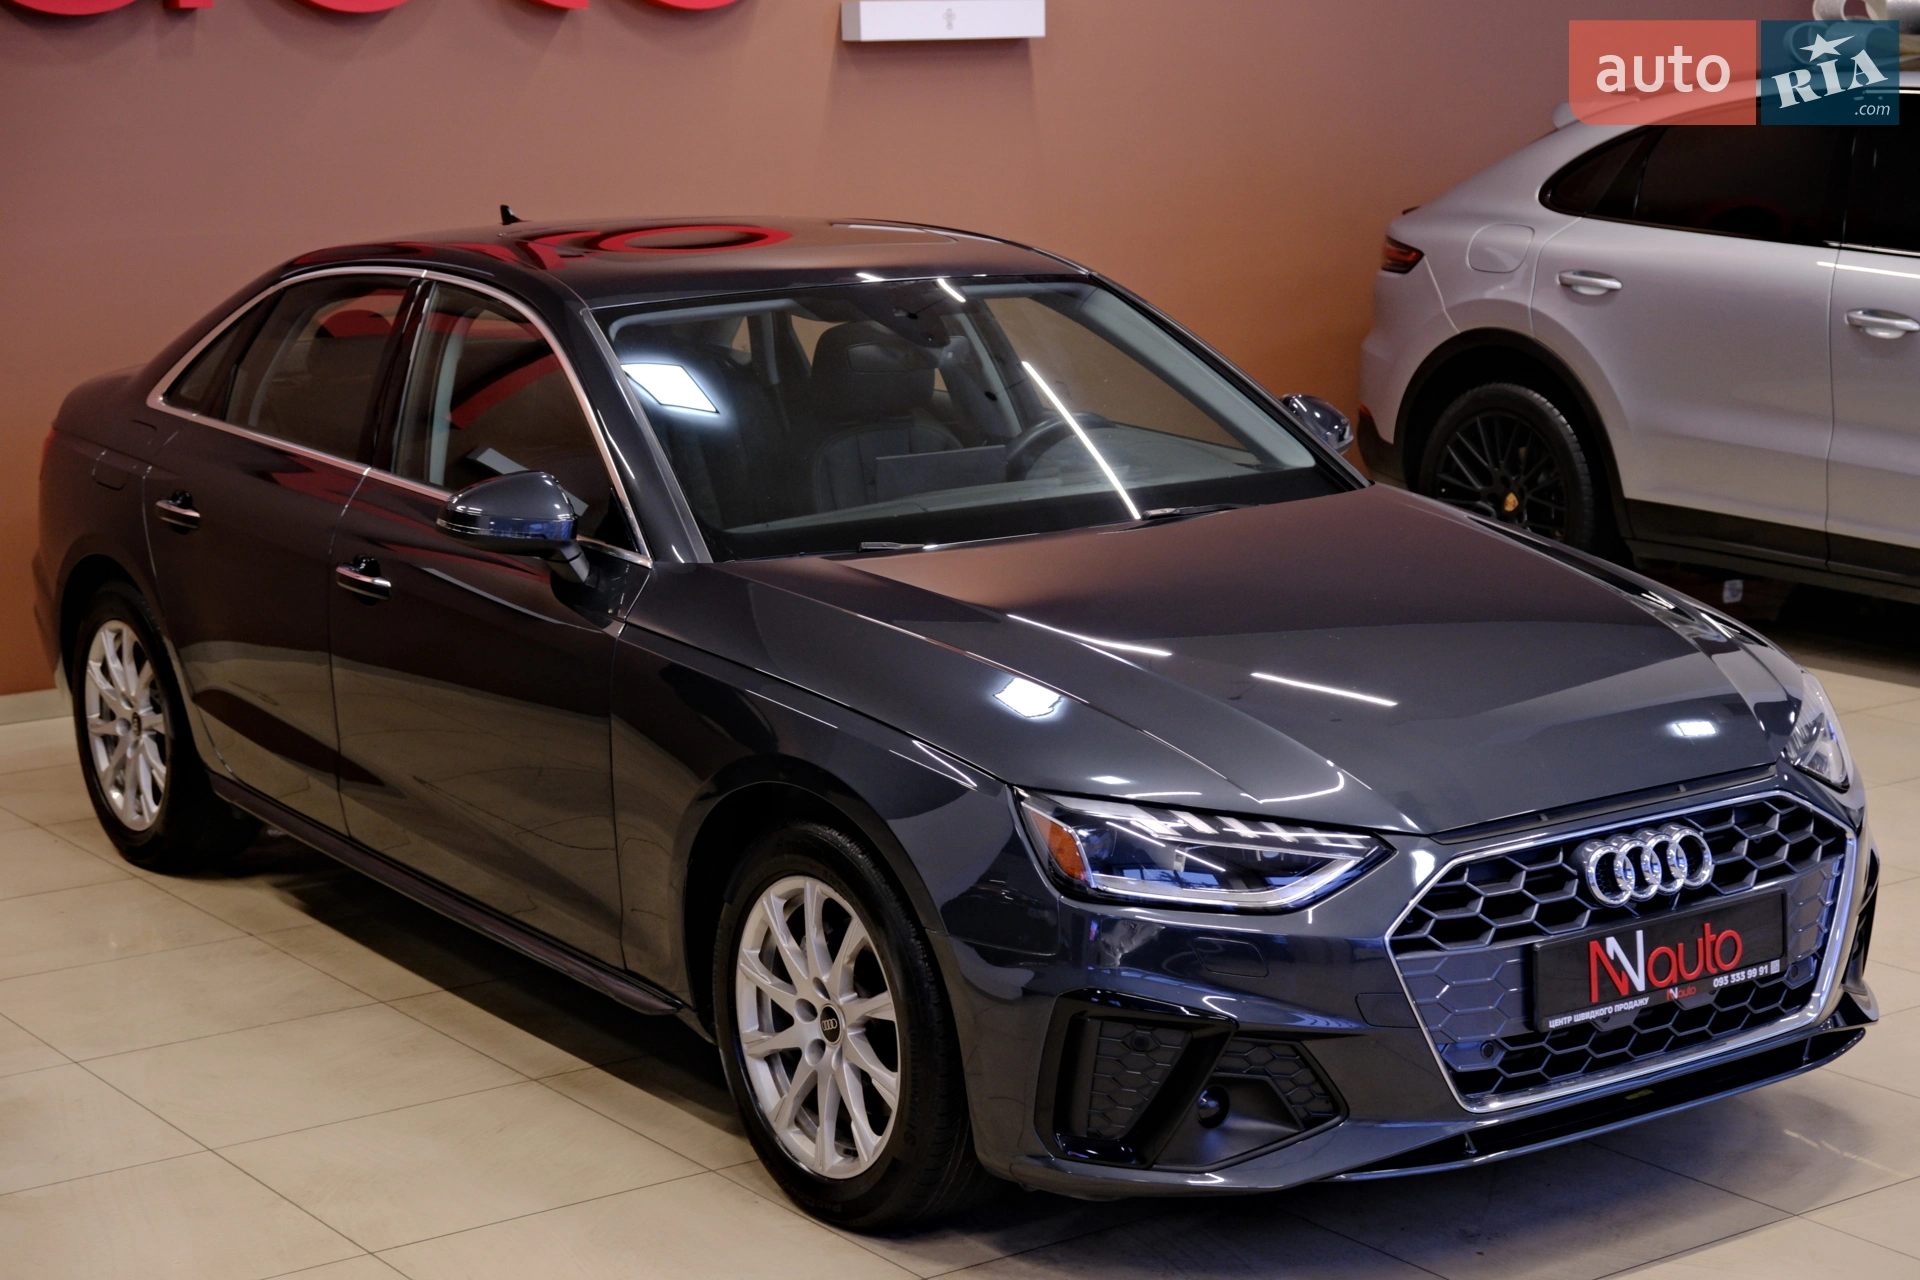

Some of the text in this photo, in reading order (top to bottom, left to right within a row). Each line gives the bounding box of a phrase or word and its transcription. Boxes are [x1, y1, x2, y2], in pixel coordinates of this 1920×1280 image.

[1713, 964, 1769, 988] 093 333 99 91
[1549, 996, 1650, 1029] ЦЕНТР ШВИДКОГО ПРОДАЖУ
